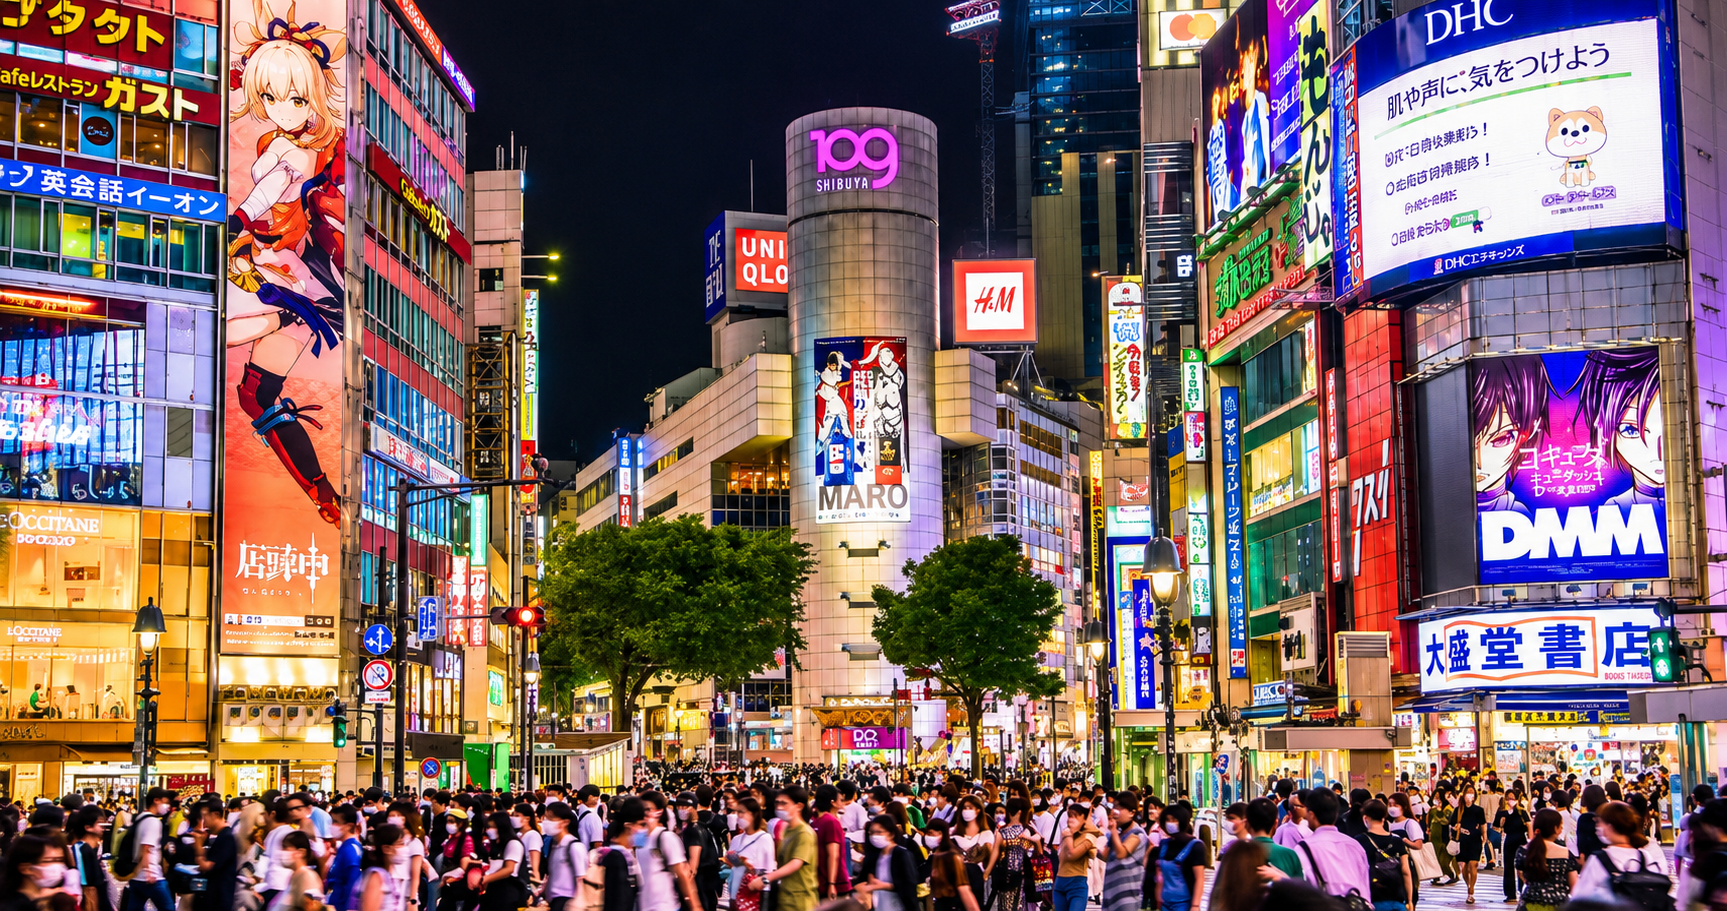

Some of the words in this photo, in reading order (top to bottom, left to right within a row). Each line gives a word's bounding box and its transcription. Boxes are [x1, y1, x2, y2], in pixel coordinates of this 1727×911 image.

[1425, 0, 1514, 45] DHC
[104, 76, 199, 121] ガスト
[810, 127, 900, 189] 109
[816, 177, 868, 192] SHIBUYA
[742, 237, 784, 259] UNI
[742, 262, 788, 287] QLO
[974, 286, 1017, 314] H&M
[818, 483, 908, 511] MARO
[1482, 503, 1665, 562] DMM
[1426, 622, 1651, 677] 大盛堂書店
